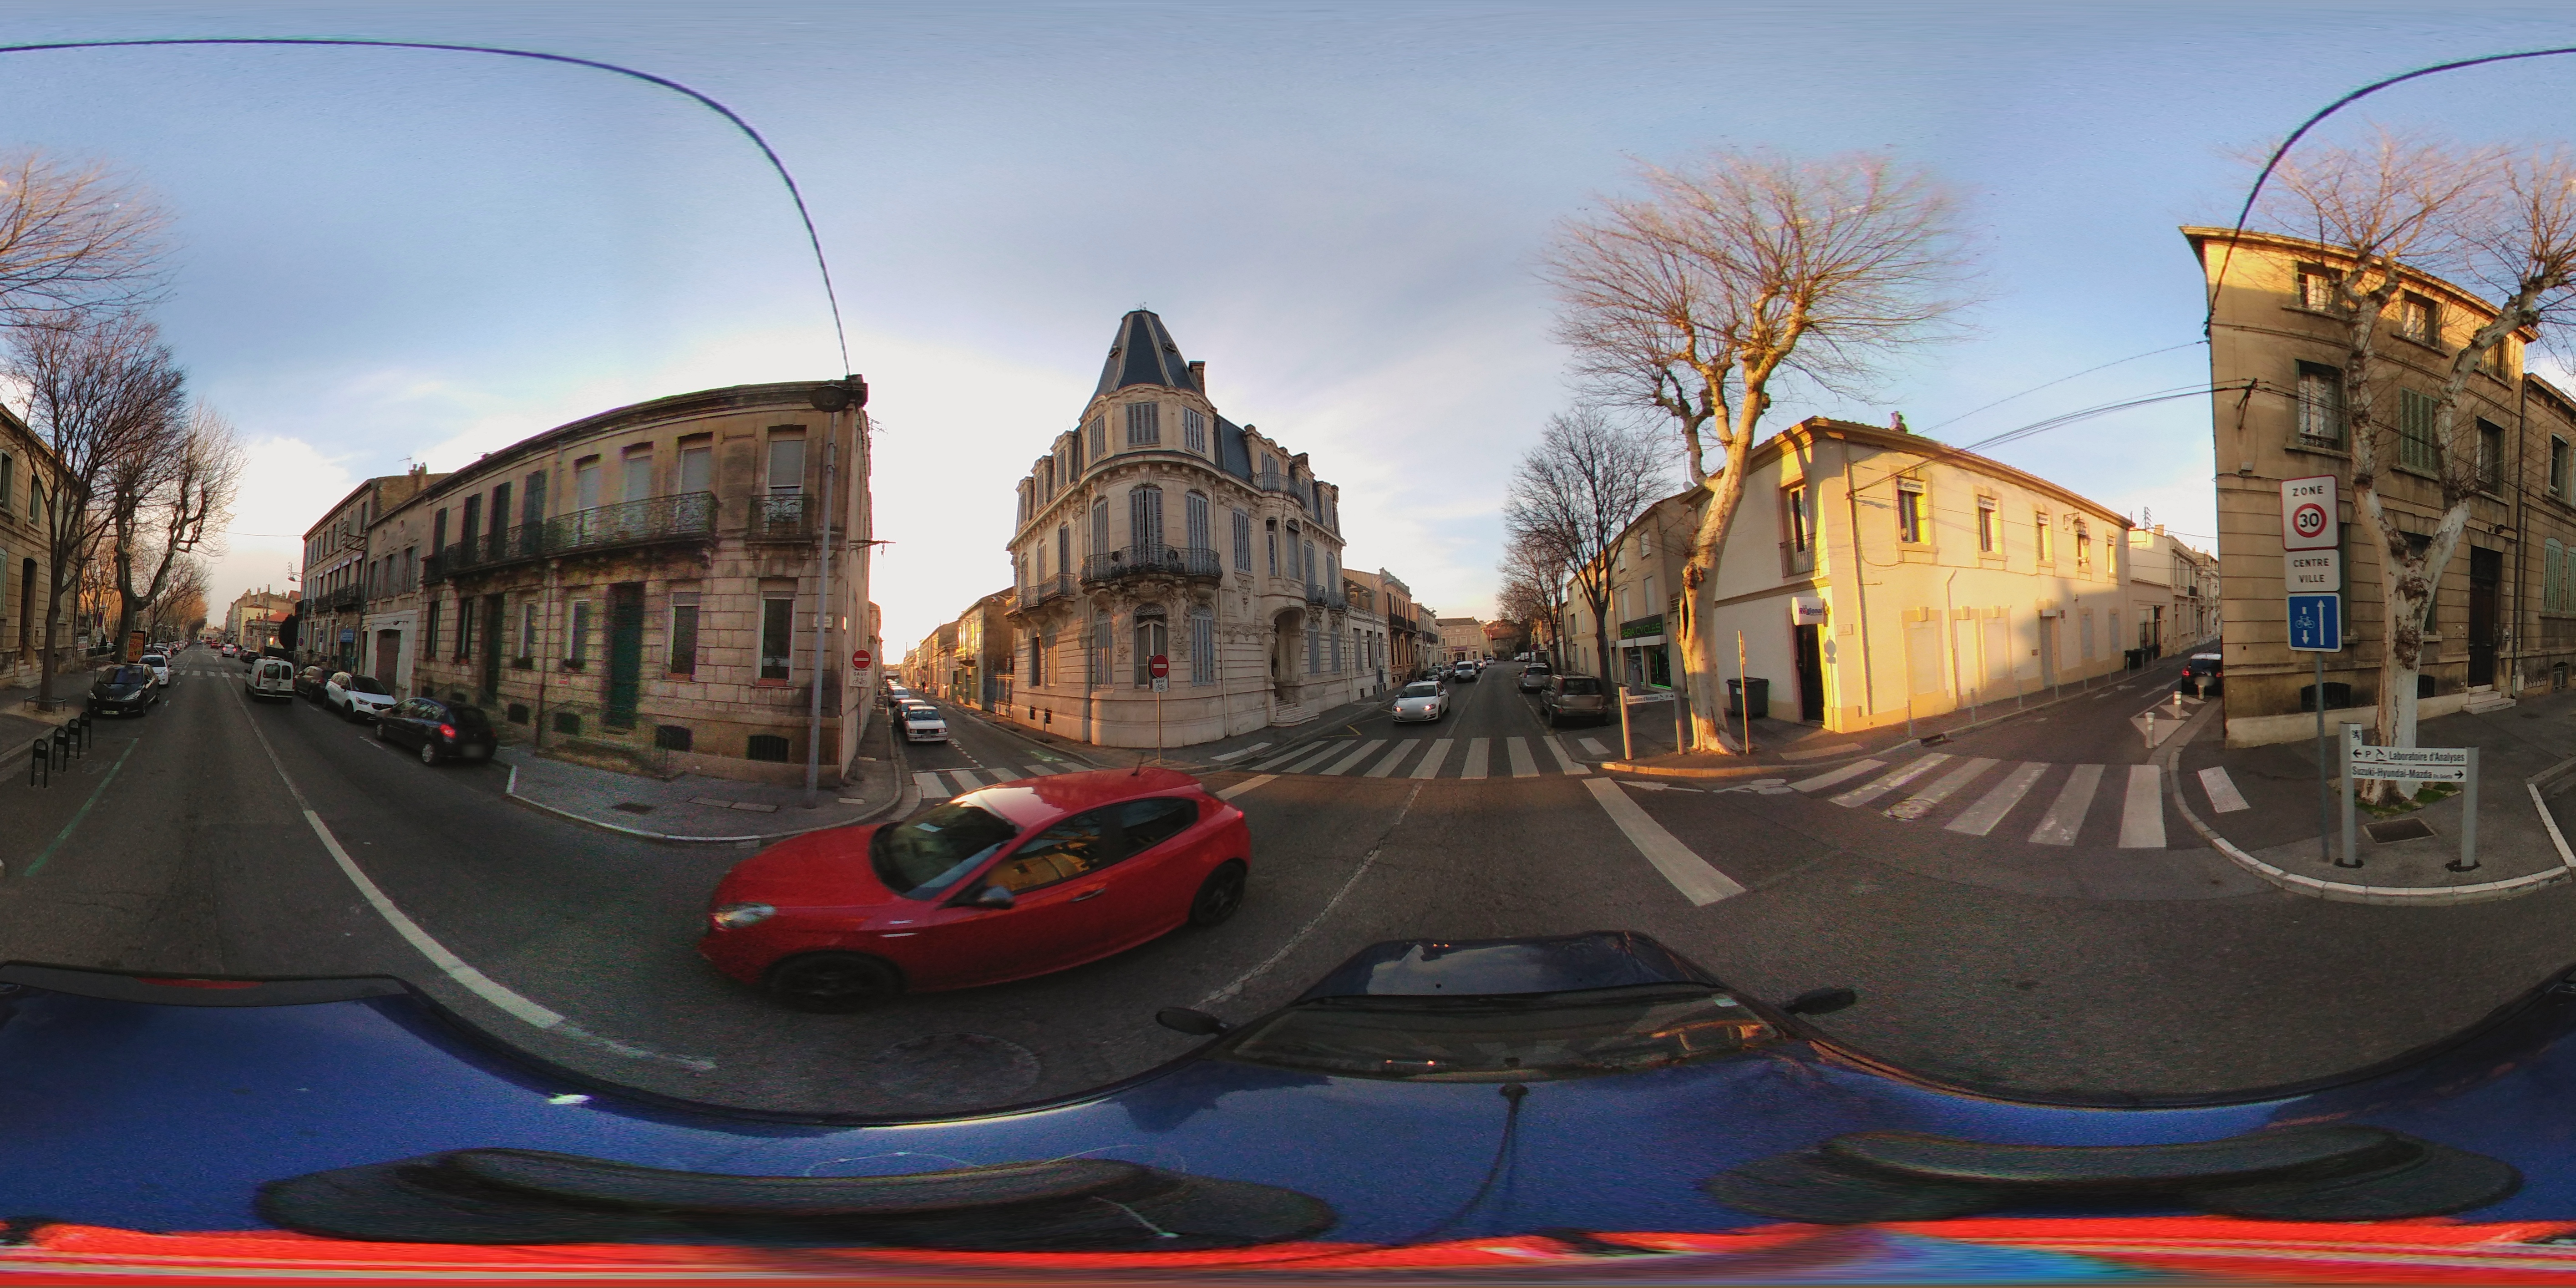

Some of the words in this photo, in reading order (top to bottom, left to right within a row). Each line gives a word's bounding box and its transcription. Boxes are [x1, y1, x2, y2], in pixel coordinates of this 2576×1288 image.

[2292, 485, 2324, 497] ZONE
[2299, 513, 2319, 528] 30
[2293, 558, 2329, 568] CENTRE
[2299, 574, 2325, 583] VILLE
[1636, 623, 1661, 635] CYCLES
[2388, 750, 2428, 761] Laboratoire
[2429, 752, 2465, 763] d'Analyses
[2352, 766, 2432, 779] Suzuki-Hyundai-Mazda
